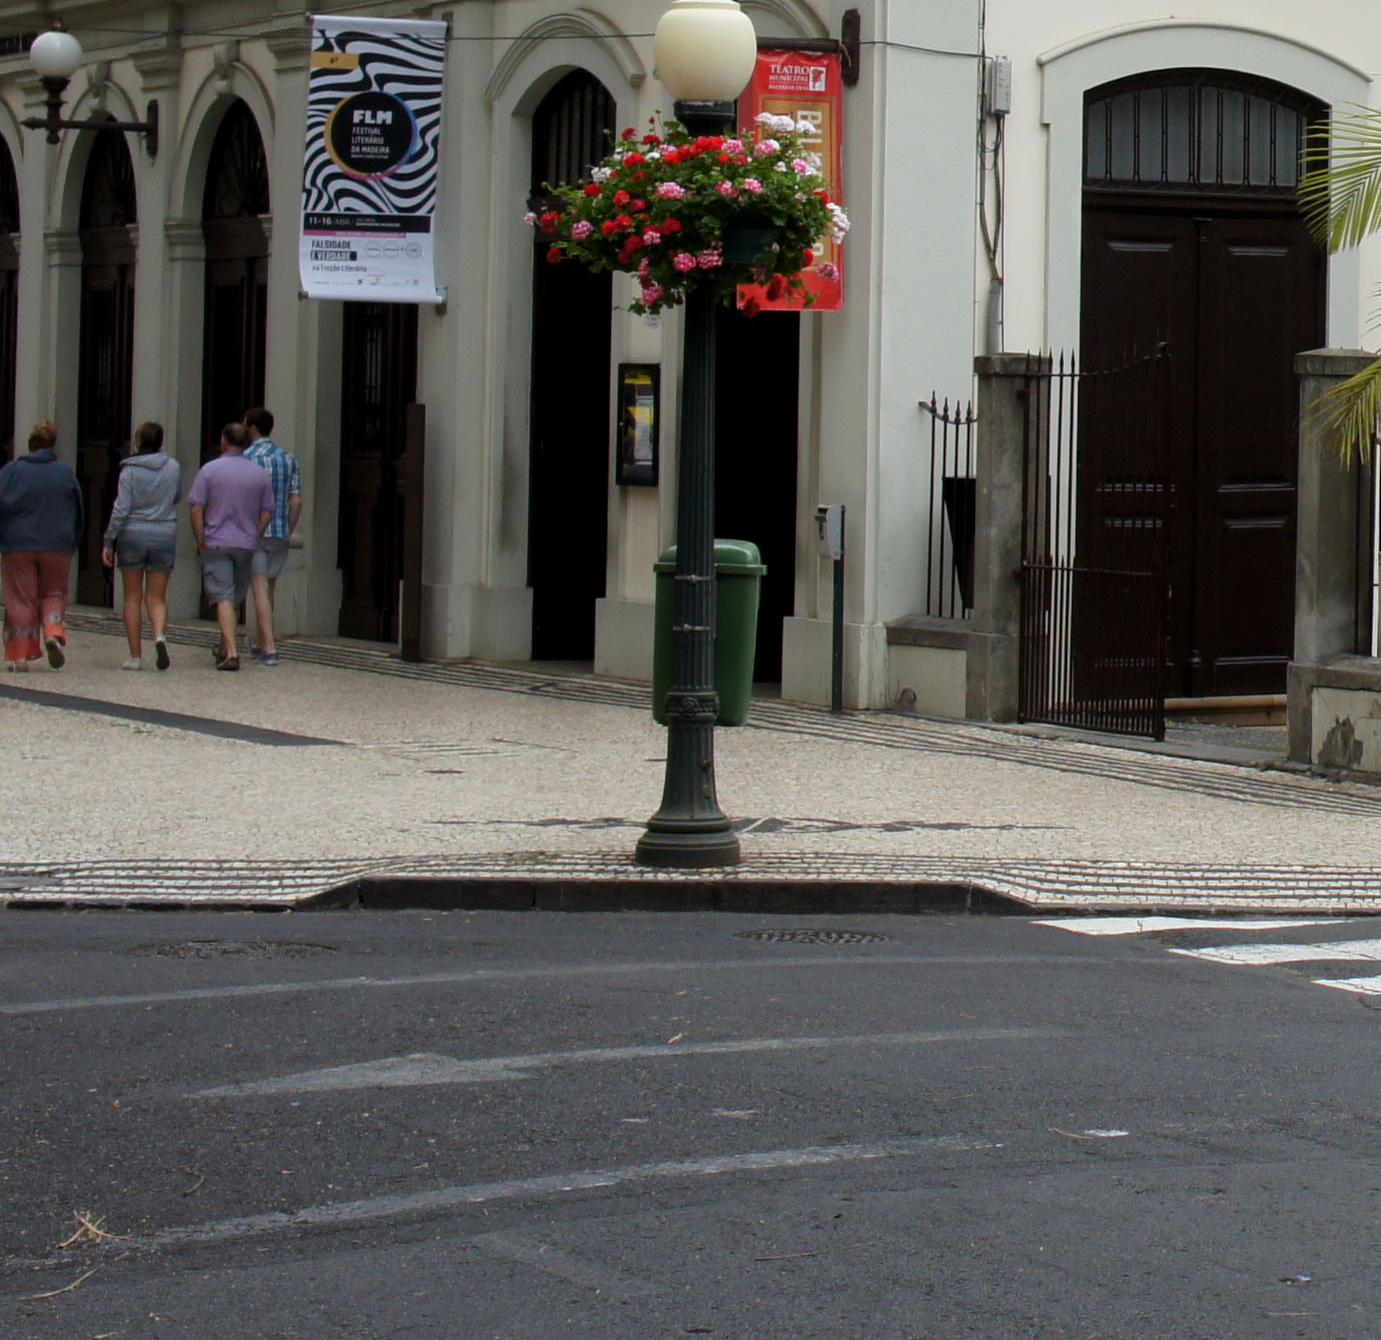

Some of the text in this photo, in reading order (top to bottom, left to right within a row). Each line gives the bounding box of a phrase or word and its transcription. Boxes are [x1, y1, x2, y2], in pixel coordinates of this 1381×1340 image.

[770, 64, 810, 75] TEATRO
[353, 109, 392, 124] FLM
[352, 126, 381, 136] FESTIVAL
[351, 145, 390, 154] DA MADEIRA
[308, 216, 332, 226] 11-16
[311, 240, 351, 250] FALSIDADE
